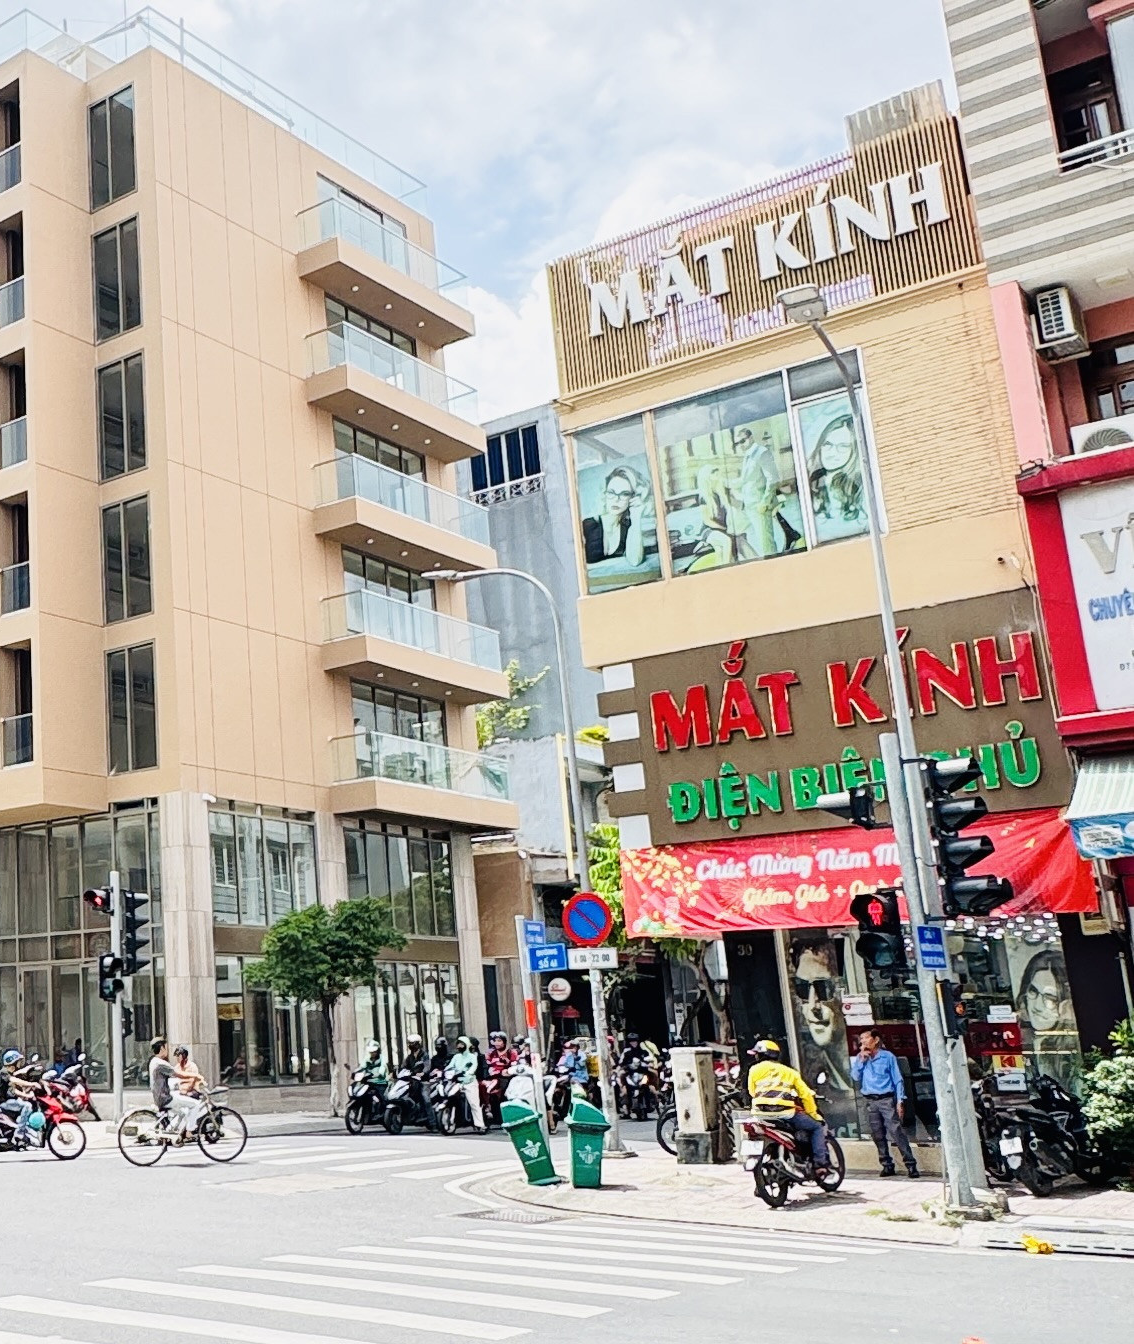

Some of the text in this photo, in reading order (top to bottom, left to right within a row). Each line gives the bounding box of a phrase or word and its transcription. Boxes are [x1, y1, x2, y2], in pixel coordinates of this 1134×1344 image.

[589, 161, 951, 337] MẮT KÍNH
[650, 640, 800, 752] MẮT
[667, 762, 782, 831] ĐIỆN
[696, 857, 747, 881] Chúc
[748, 852, 813, 879] Mừng
[816, 847, 870, 871] Năm
